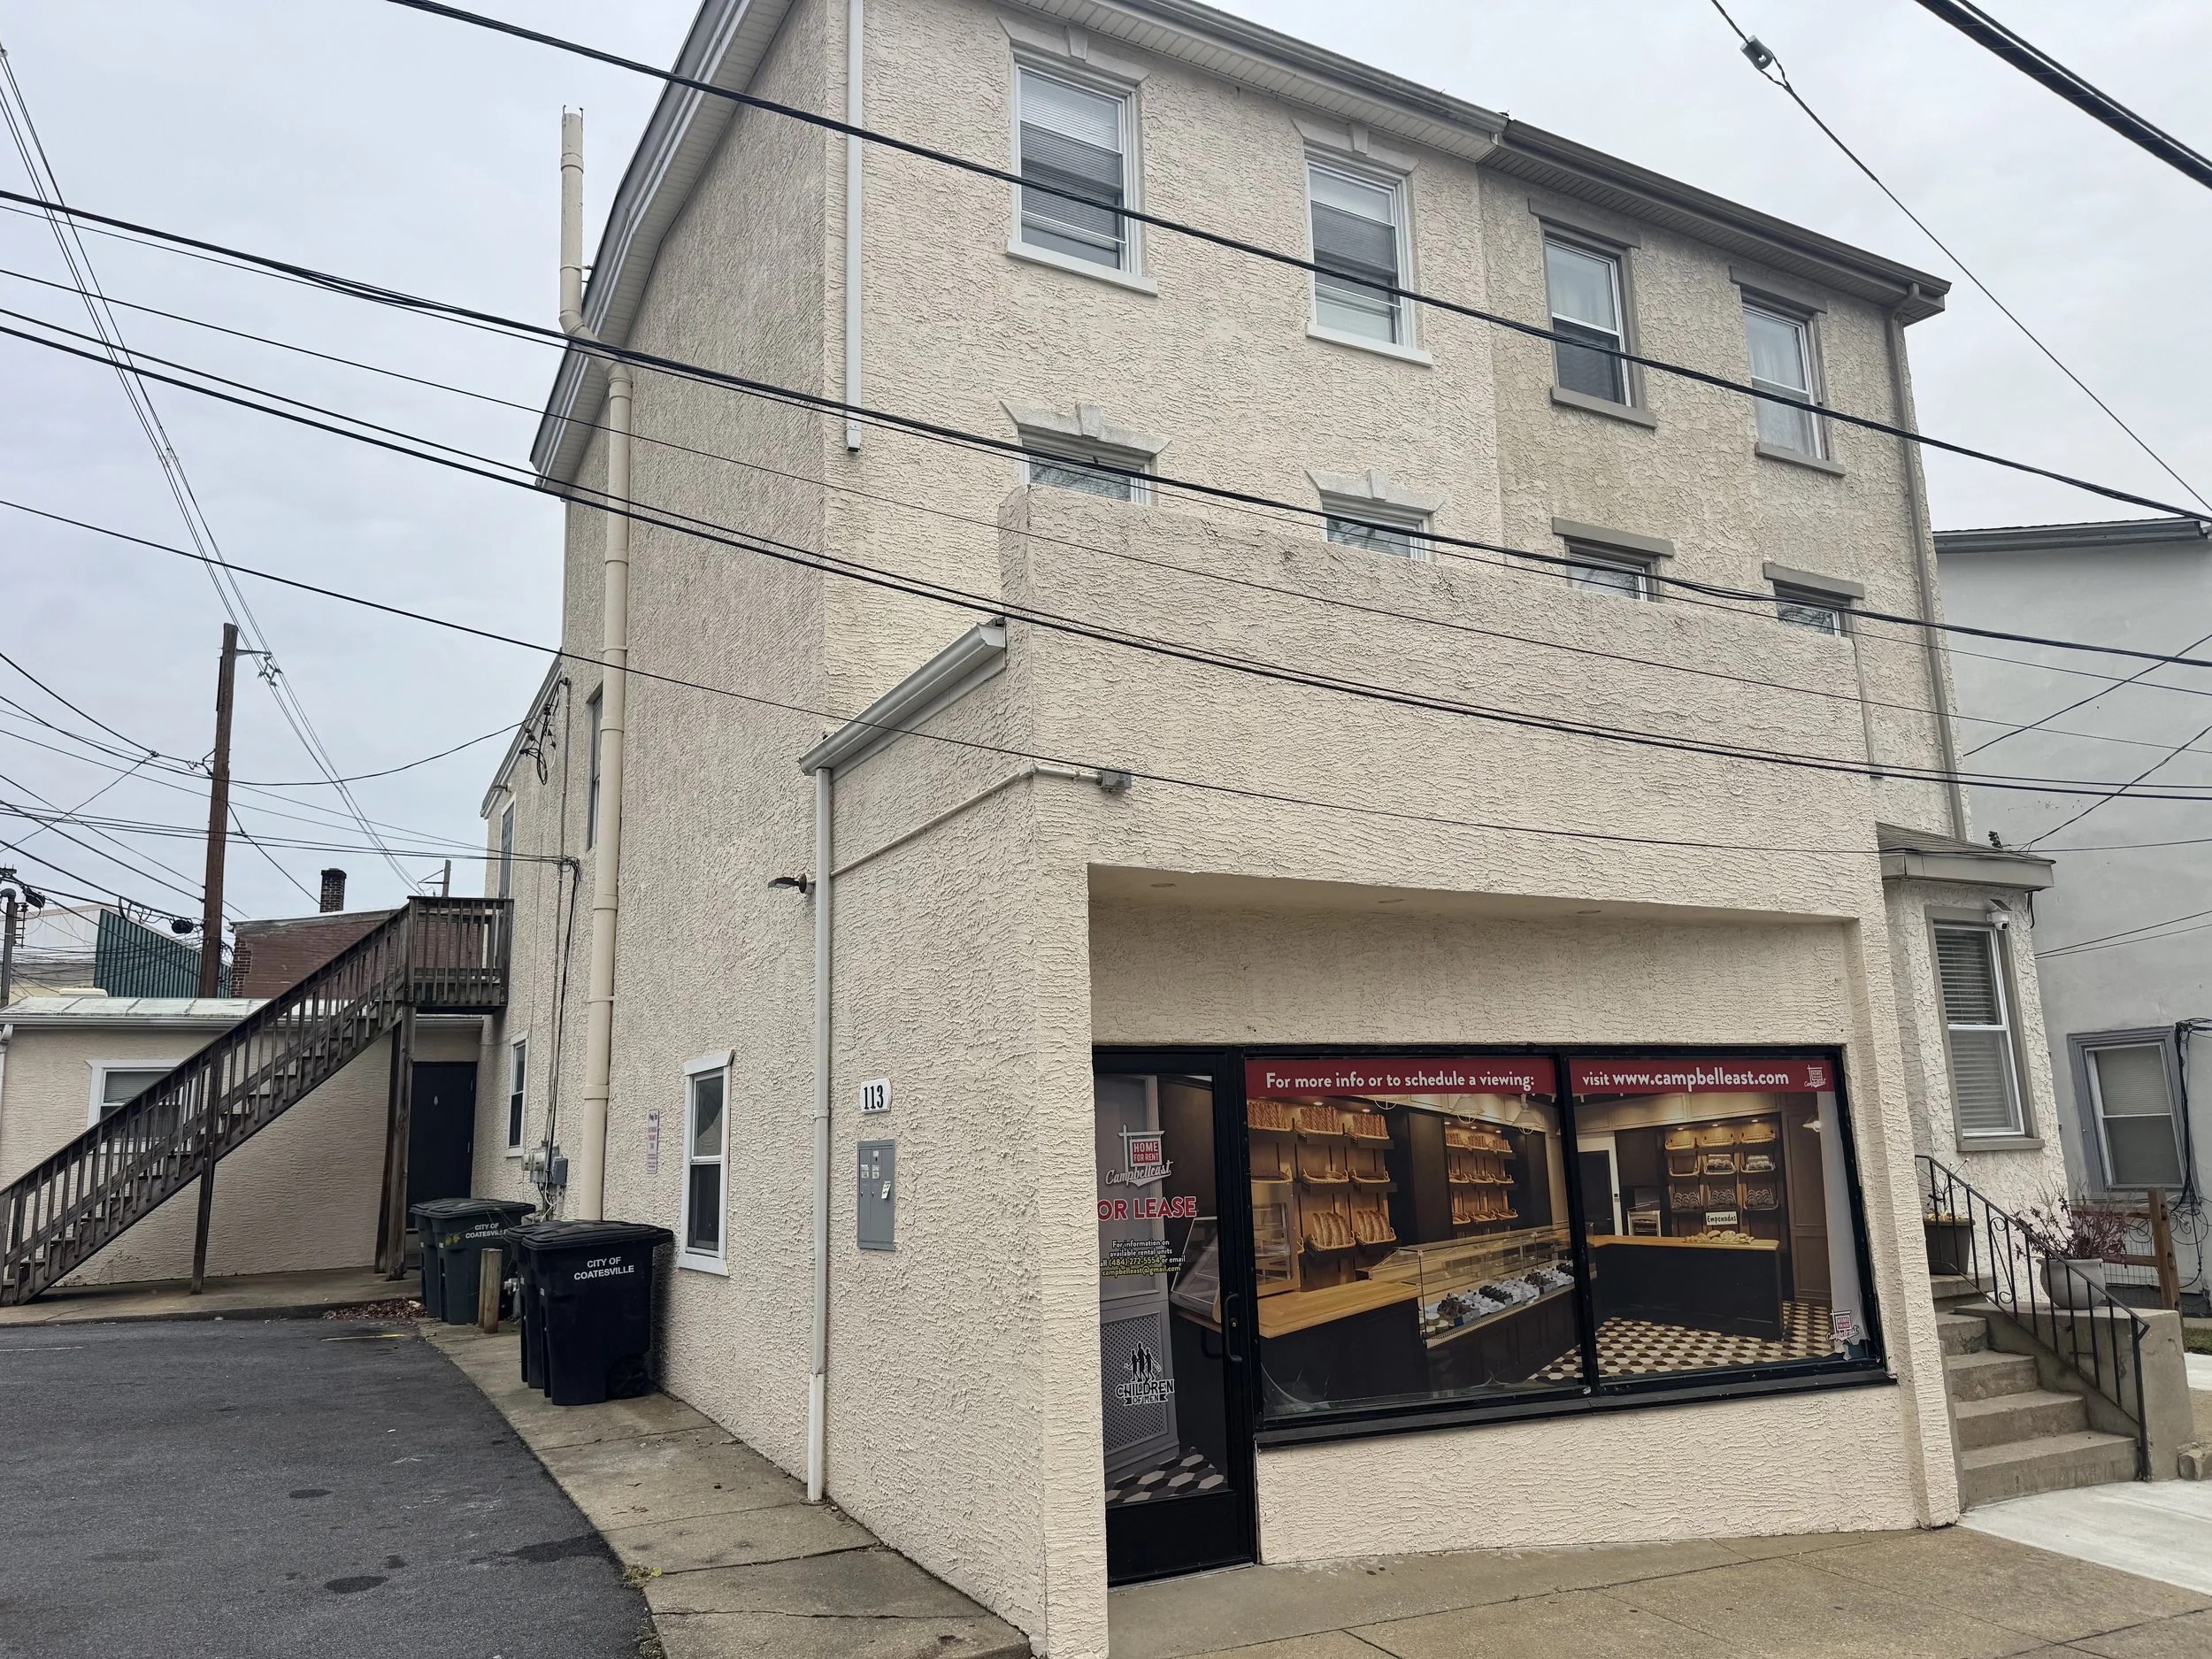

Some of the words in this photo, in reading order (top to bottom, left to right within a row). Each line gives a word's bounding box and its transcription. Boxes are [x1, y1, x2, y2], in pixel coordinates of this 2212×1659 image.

[1266, 1072, 1291, 1088] For
[1294, 1077, 1332, 1088] more
[1335, 1071, 1364, 1087] info
[1368, 1076, 1383, 1087] or
[1386, 1074, 1401, 1087] to
[1405, 1071, 1465, 1087] schedule
[1469, 1076, 1476, 1086] a
[1479, 1071, 1534, 1092] viewing:
[1582, 1071, 1609, 1086] visit
[1612, 1067, 1789, 1092] www.campbelleast.com
[864, 1084, 884, 1110] 113
[1133, 1141, 1158, 1153] HOME
[1133, 1153, 1145, 1162] FOR
[1145, 1152, 1159, 1161] RENT
[1105, 1159, 1174, 1186] Campbelleast
[1097, 1199, 1128, 1221] OR
[1133, 1196, 1197, 1220] LEASE
[587, 1258, 607, 1268] CITY
[609, 1256, 622, 1265] OF
[1109, 1257, 1128, 1266] (484)
[1129, 1256, 1160, 1265] 272-5554
[573, 1265, 635, 1280] COATESVILLE
[1102, 1265, 1181, 1278] campbelleast@gmail.com
[1115, 1379, 1175, 1398] CHILDREN
[1143, 1394, 1159, 1403] MEN
